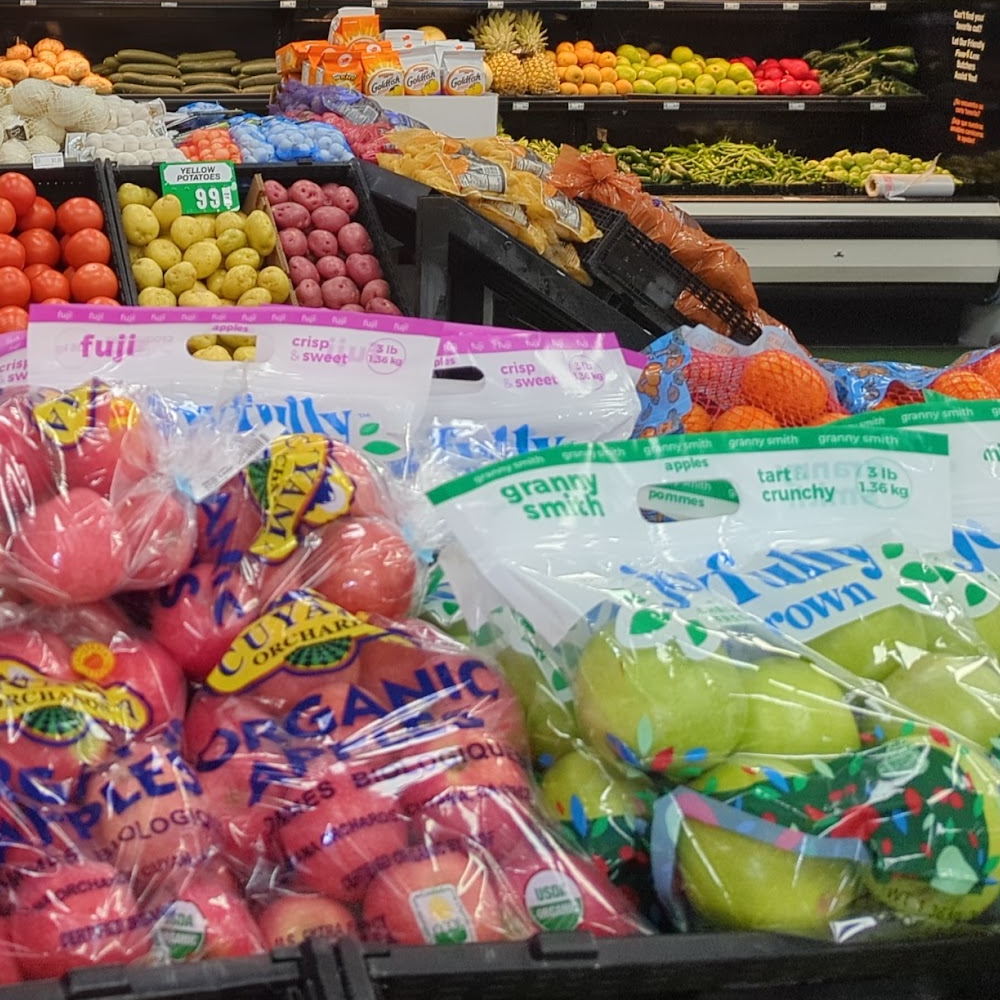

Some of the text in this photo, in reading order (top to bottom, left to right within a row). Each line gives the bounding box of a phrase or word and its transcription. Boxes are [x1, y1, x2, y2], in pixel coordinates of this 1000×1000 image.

[371, 76, 401, 93] Goldfish
[406, 70, 437, 87] Goldfish
[451, 72, 481, 89] Goldfish
[176, 173, 221, 182] POTATOES
[180, 166, 216, 175] YELLOW
[195, 187, 221, 210] 99
[57, 310, 74, 320] fuji
[88, 312, 104, 322] fuji
[119, 312, 136, 323] fuji
[150, 312, 167, 322] fuji
[181, 313, 197, 322] fuji
[211, 312, 227, 321] fuji
[241, 312, 257, 323] fuji
[271, 312, 287, 322] fuji
[301, 313, 317, 323] fuji
[331, 316, 348, 326] fuji
[362, 319, 378, 329] fuji
[394, 322, 410, 332] fuji
[80, 333, 398, 362] fuji crisp 3 lb
[302, 351, 349, 365] sweet
[390, 356, 403, 368] kg
[500, 362, 536, 378] crisp
[515, 374, 558, 389] sweet
[901, 407, 974, 424] granny smith
[728, 433, 799, 449] granny smith
[818, 432, 899, 446] granny smith
[473, 454, 546, 484] granny smith
[664, 457, 709, 473] apples
[500, 465, 898, 504] granny tart 3 lb
[522, 491, 606, 520] smith
[762, 482, 836, 504] crunchy
[889, 484, 910, 500] kg
[648, 489, 705, 508] pommes
[765, 580, 879, 631] rown
[217, 595, 354, 678] CUYA
